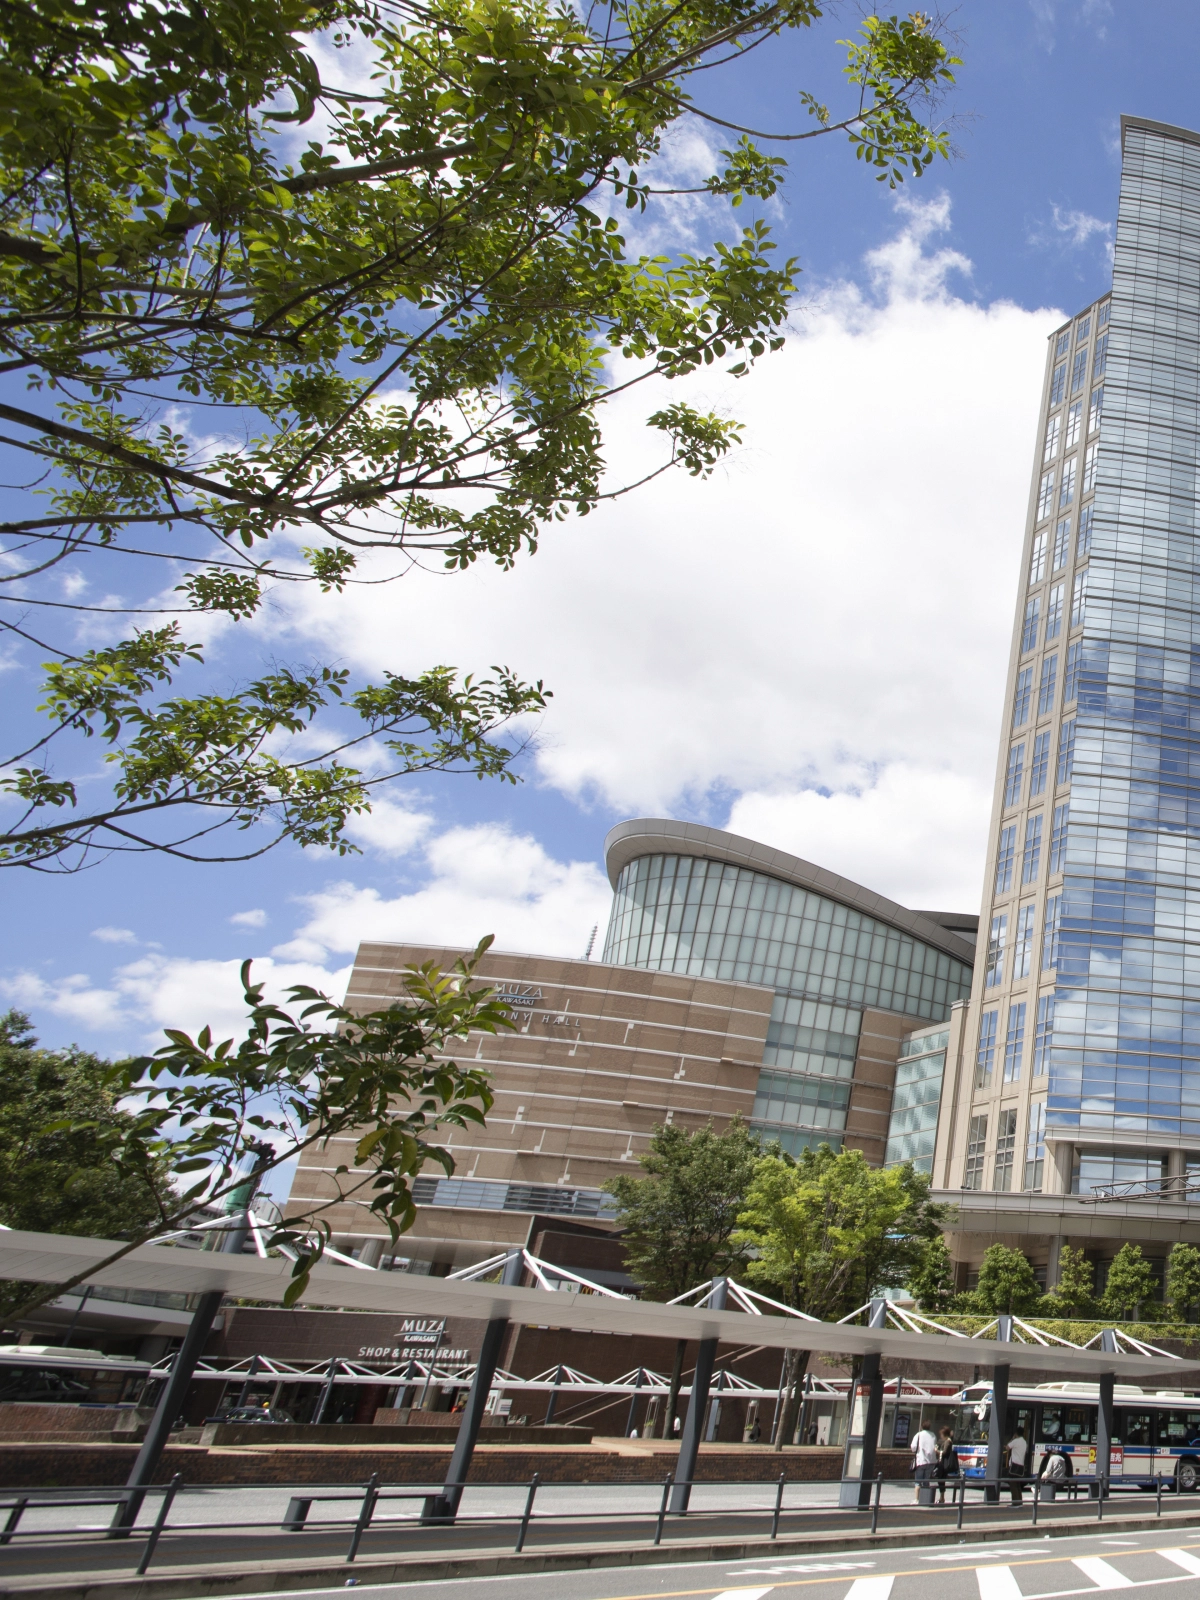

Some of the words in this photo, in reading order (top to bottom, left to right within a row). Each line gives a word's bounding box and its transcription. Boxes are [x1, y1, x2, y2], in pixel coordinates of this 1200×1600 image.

[493, 983, 543, 998] MUZA
[496, 997, 534, 1006] KAWASAKI
[541, 1014, 581, 1027] HALL
[400, 1319, 445, 1332] MUZA
[403, 1335, 437, 1343] KAWASAKI
[358, 1346, 390, 1358] SHOP
[391, 1348, 399, 1358] &
